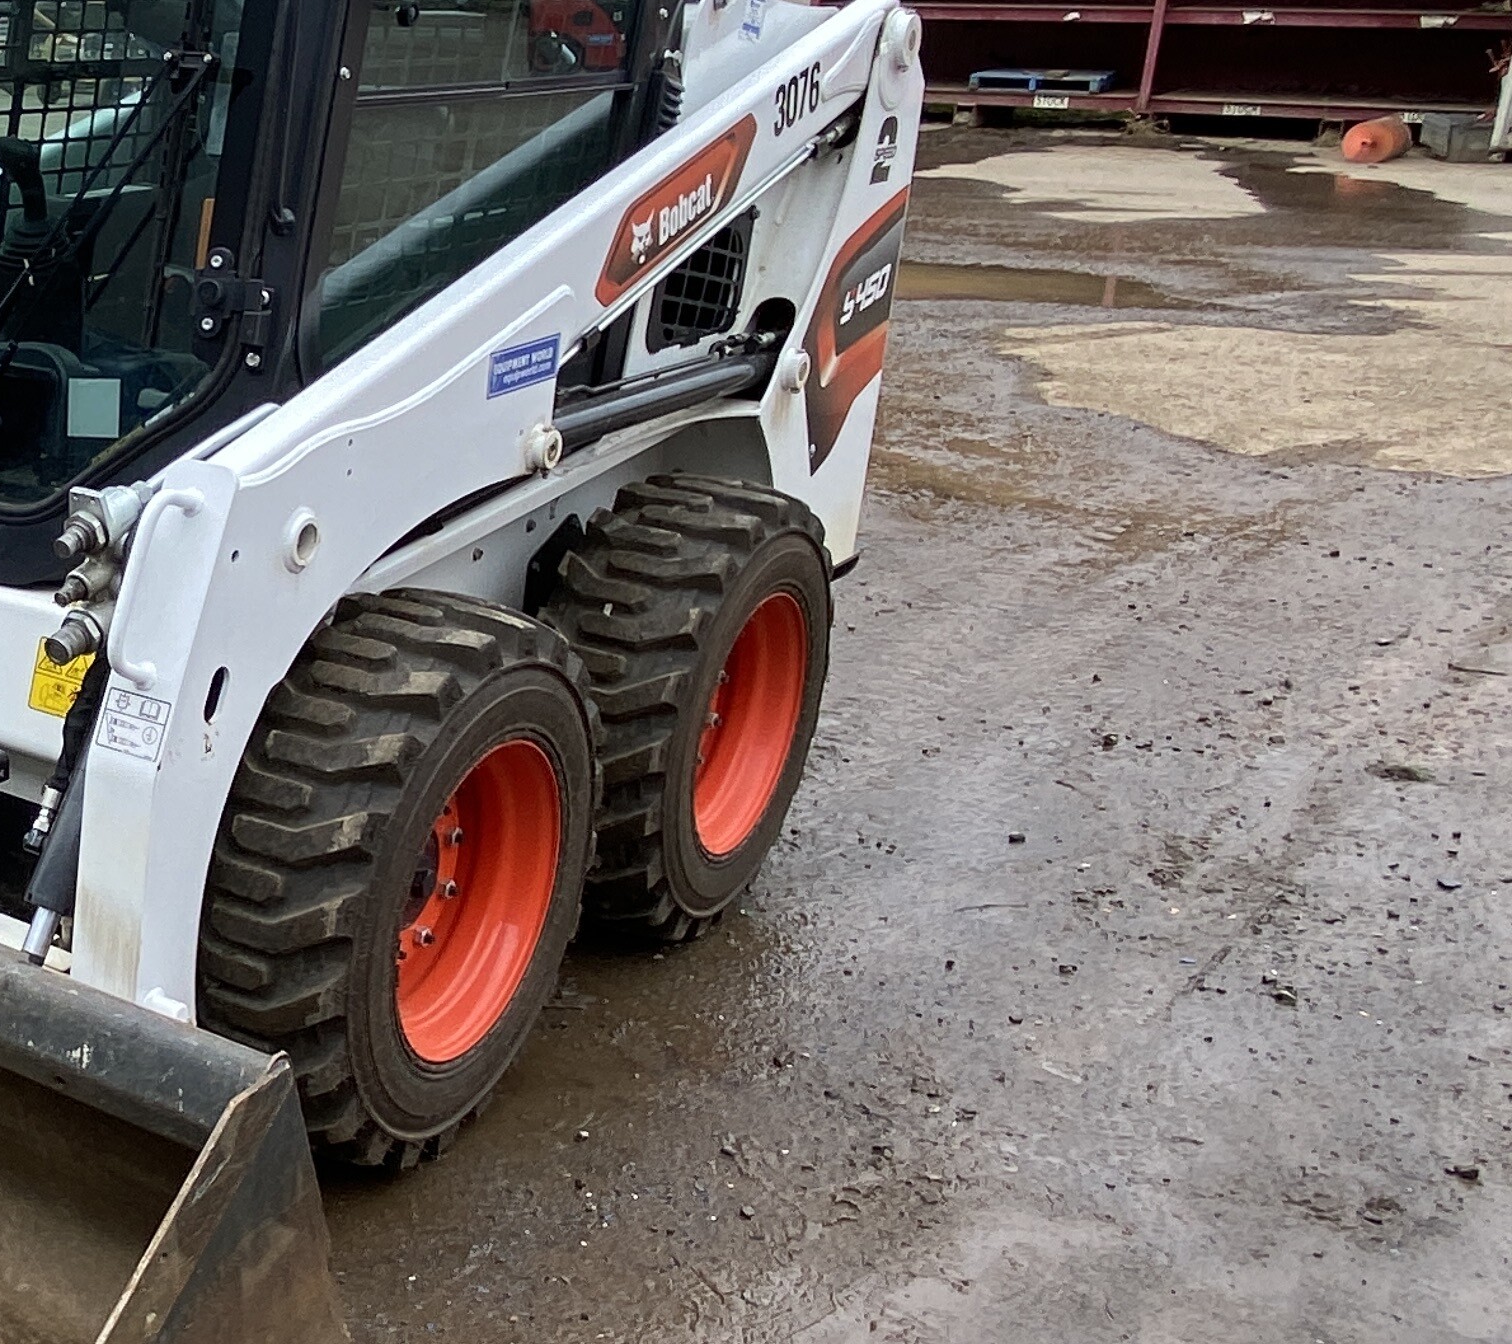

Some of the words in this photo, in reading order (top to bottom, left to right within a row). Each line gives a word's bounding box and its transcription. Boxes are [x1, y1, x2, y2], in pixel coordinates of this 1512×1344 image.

[774, 61, 820, 137] 3076
[659, 173, 712, 246] Bobcat
[839, 263, 892, 325] S450
[531, 346, 554, 364] WORLD
